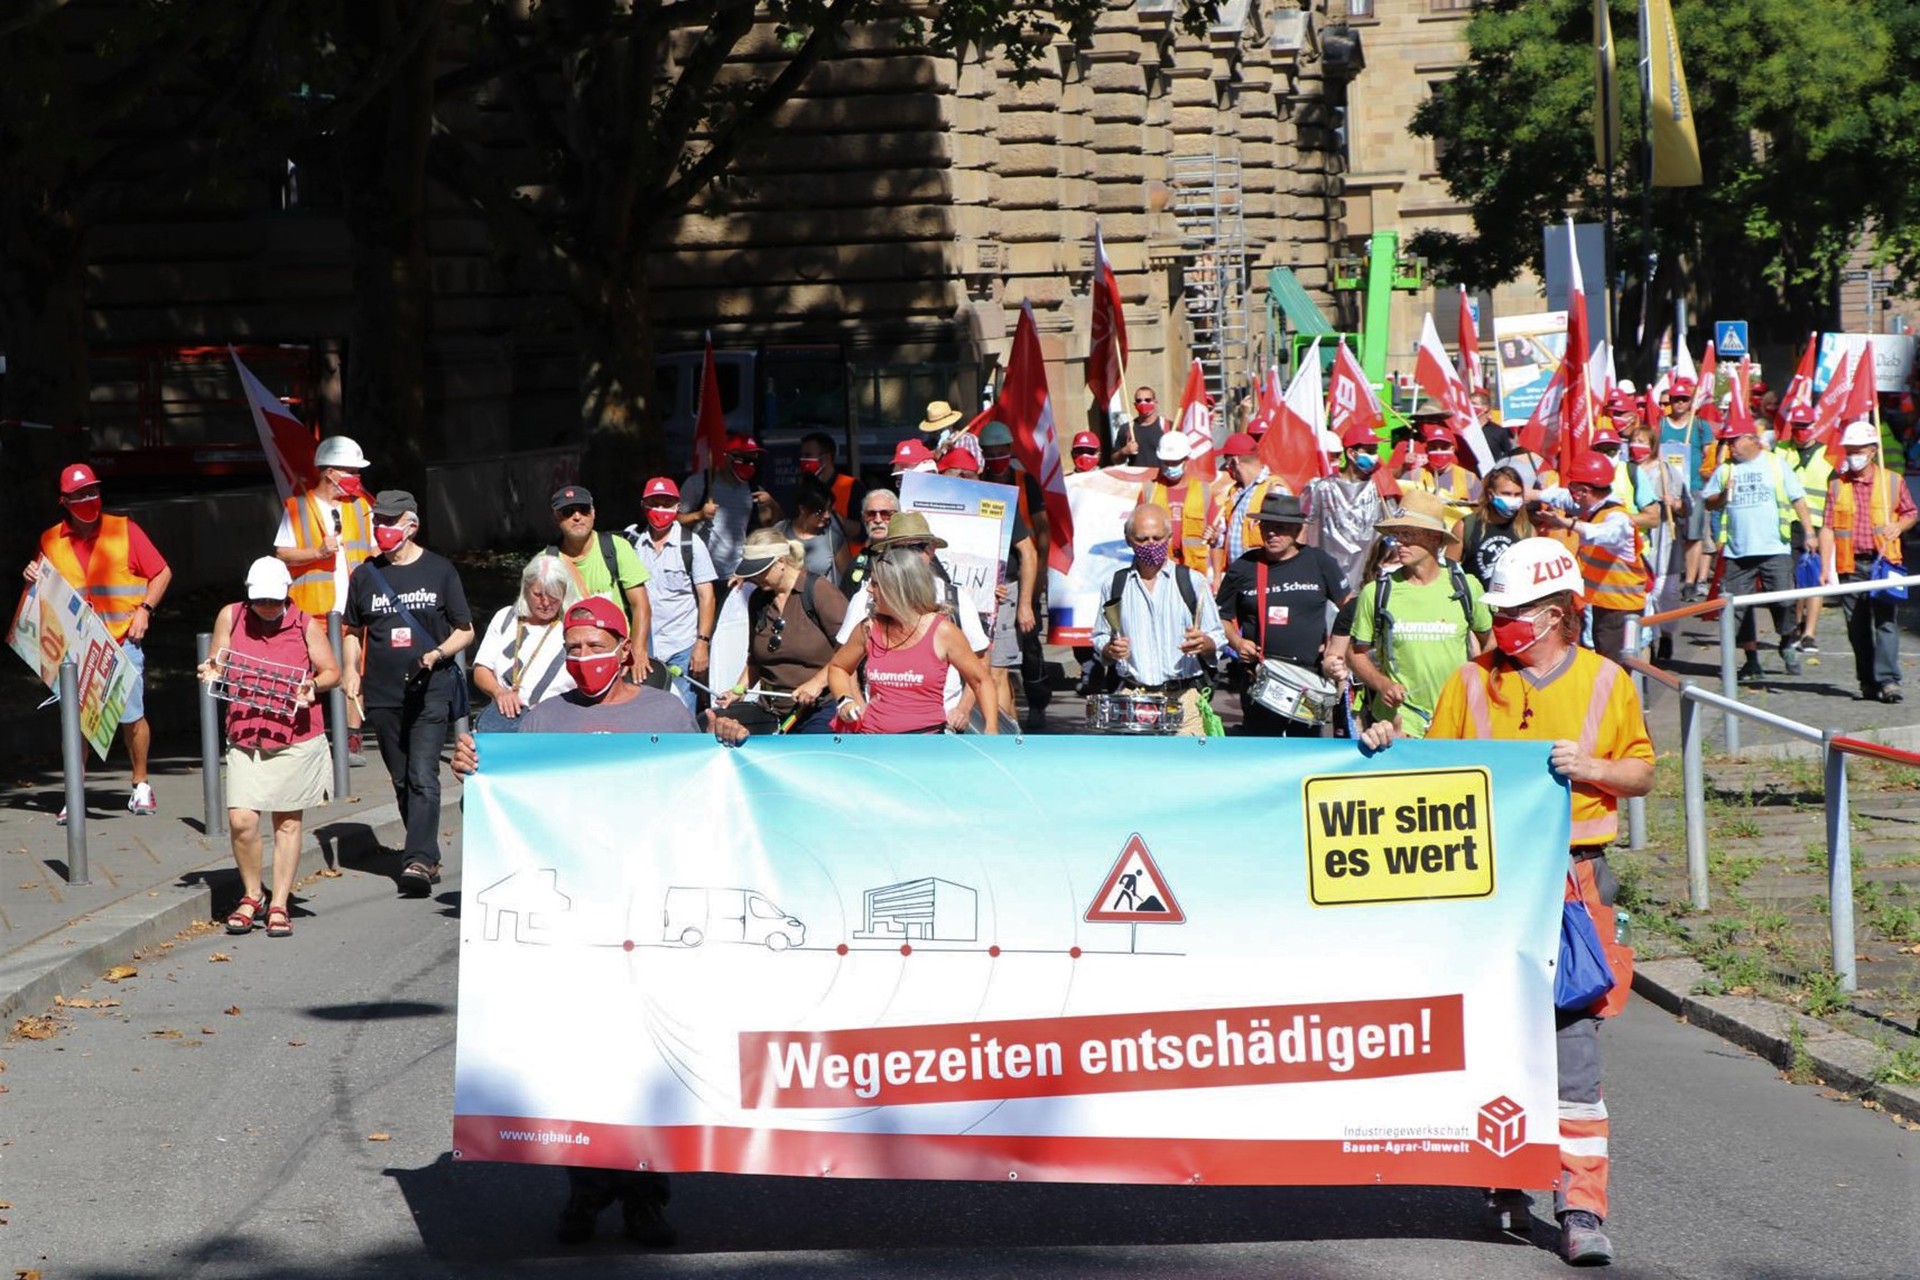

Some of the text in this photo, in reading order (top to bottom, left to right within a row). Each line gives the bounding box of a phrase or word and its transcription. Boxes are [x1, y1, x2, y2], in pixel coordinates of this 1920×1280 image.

[1318, 794, 1478, 838] Wir sind
[1325, 835, 1479, 879] es wert
[767, 1007, 1432, 1099] Wegezeiten entschädigen!
[499, 1129, 591, 1145] www.igbau.de
[1342, 1140, 1471, 1155] Bauen-Agrar-Umwelt
[1343, 1125, 1470, 1140] Industriegewerkschaft
